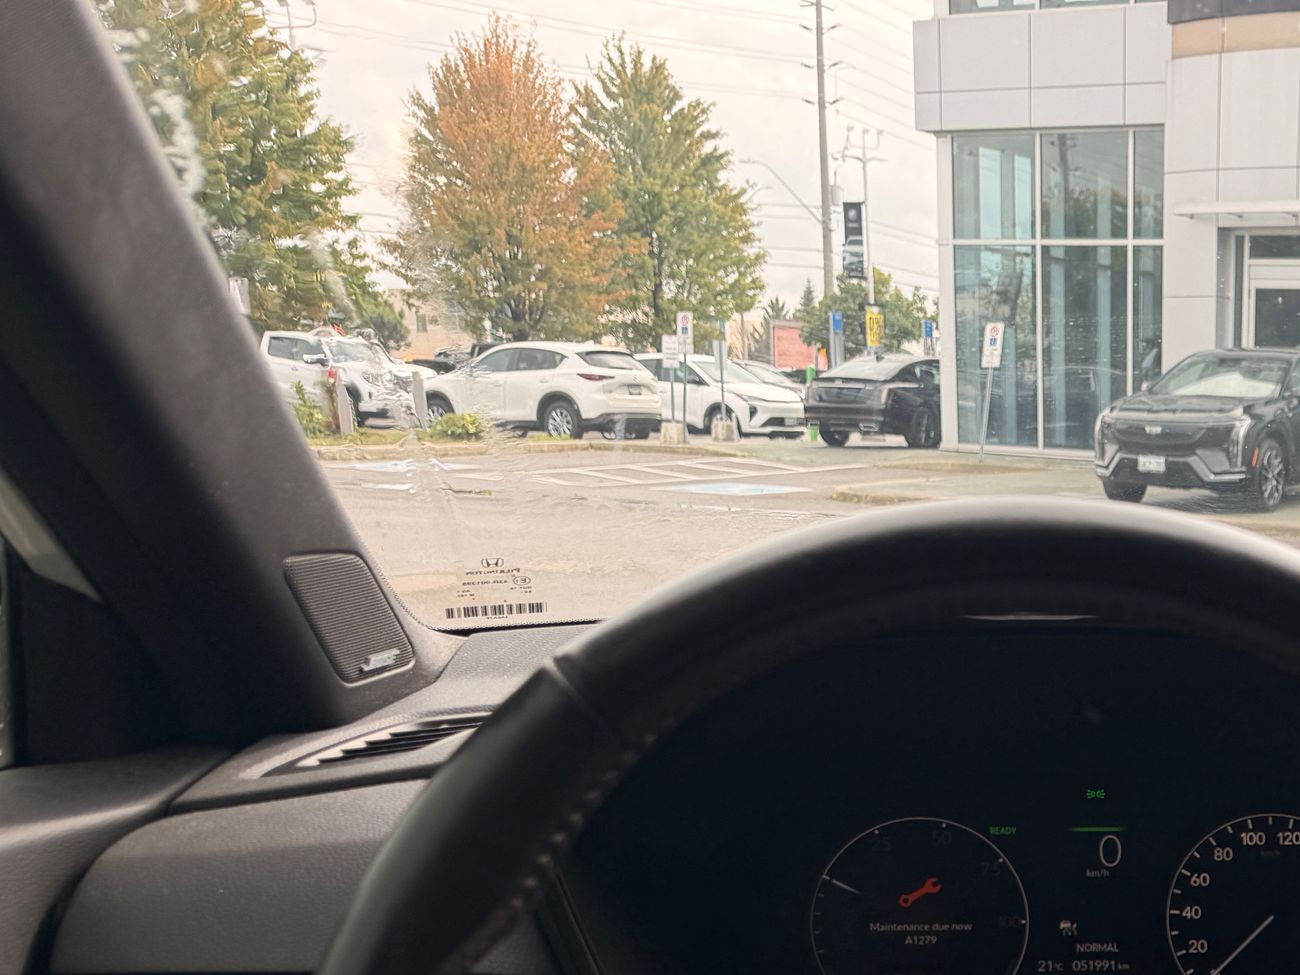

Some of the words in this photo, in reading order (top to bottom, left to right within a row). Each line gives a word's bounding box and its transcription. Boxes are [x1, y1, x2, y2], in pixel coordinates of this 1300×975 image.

[989, 827, 1018, 837] READY
[1240, 831, 1266, 846] 100
[1098, 834, 1122, 868] 0
[1212, 847, 1234, 861] 80
[1086, 867, 1110, 878] km/h
[1190, 872, 1210, 887] 60
[1181, 905, 1202, 920] 40
[869, 921, 929, 932] Maintenance
[931, 921, 950, 931] due
[951, 923, 973, 931] now
[904, 935, 938, 945] A1279
[1188, 939, 1208, 954] 20
[1076, 942, 1119, 953] NORMAL
[1071, 959, 1116, 972] 051991
